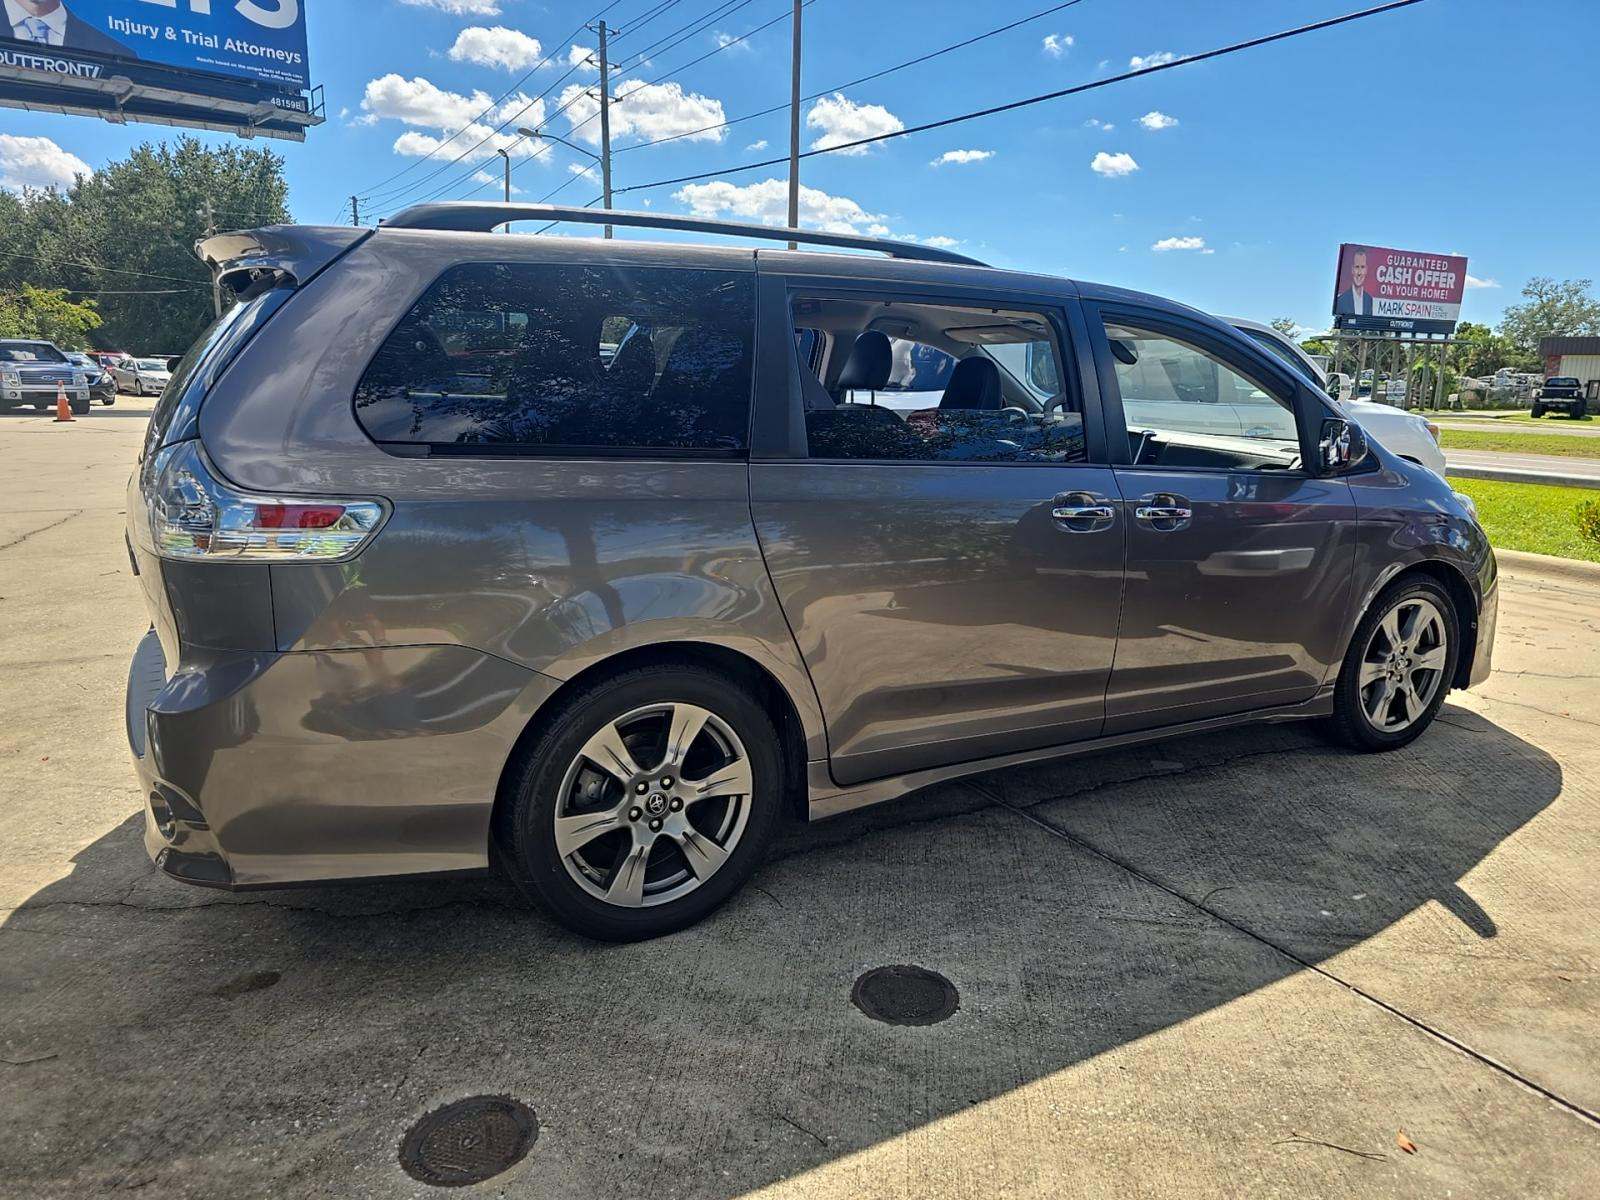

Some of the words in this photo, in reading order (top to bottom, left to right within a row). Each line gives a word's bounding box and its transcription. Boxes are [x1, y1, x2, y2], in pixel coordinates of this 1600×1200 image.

[108, 15, 158, 39] Injury
[165, 26, 177, 41] &
[181, 29, 218, 48] Trial
[224, 38, 302, 64] Attorneys
[1387, 255, 1448, 270] GUARANTEED
[1376, 265, 1412, 285] CASH
[1415, 270, 1456, 289] OFFER
[1380, 285, 1392, 295] ON
[1395, 285, 1418, 297] YOUR
[1421, 289, 1448, 299] HOME!
